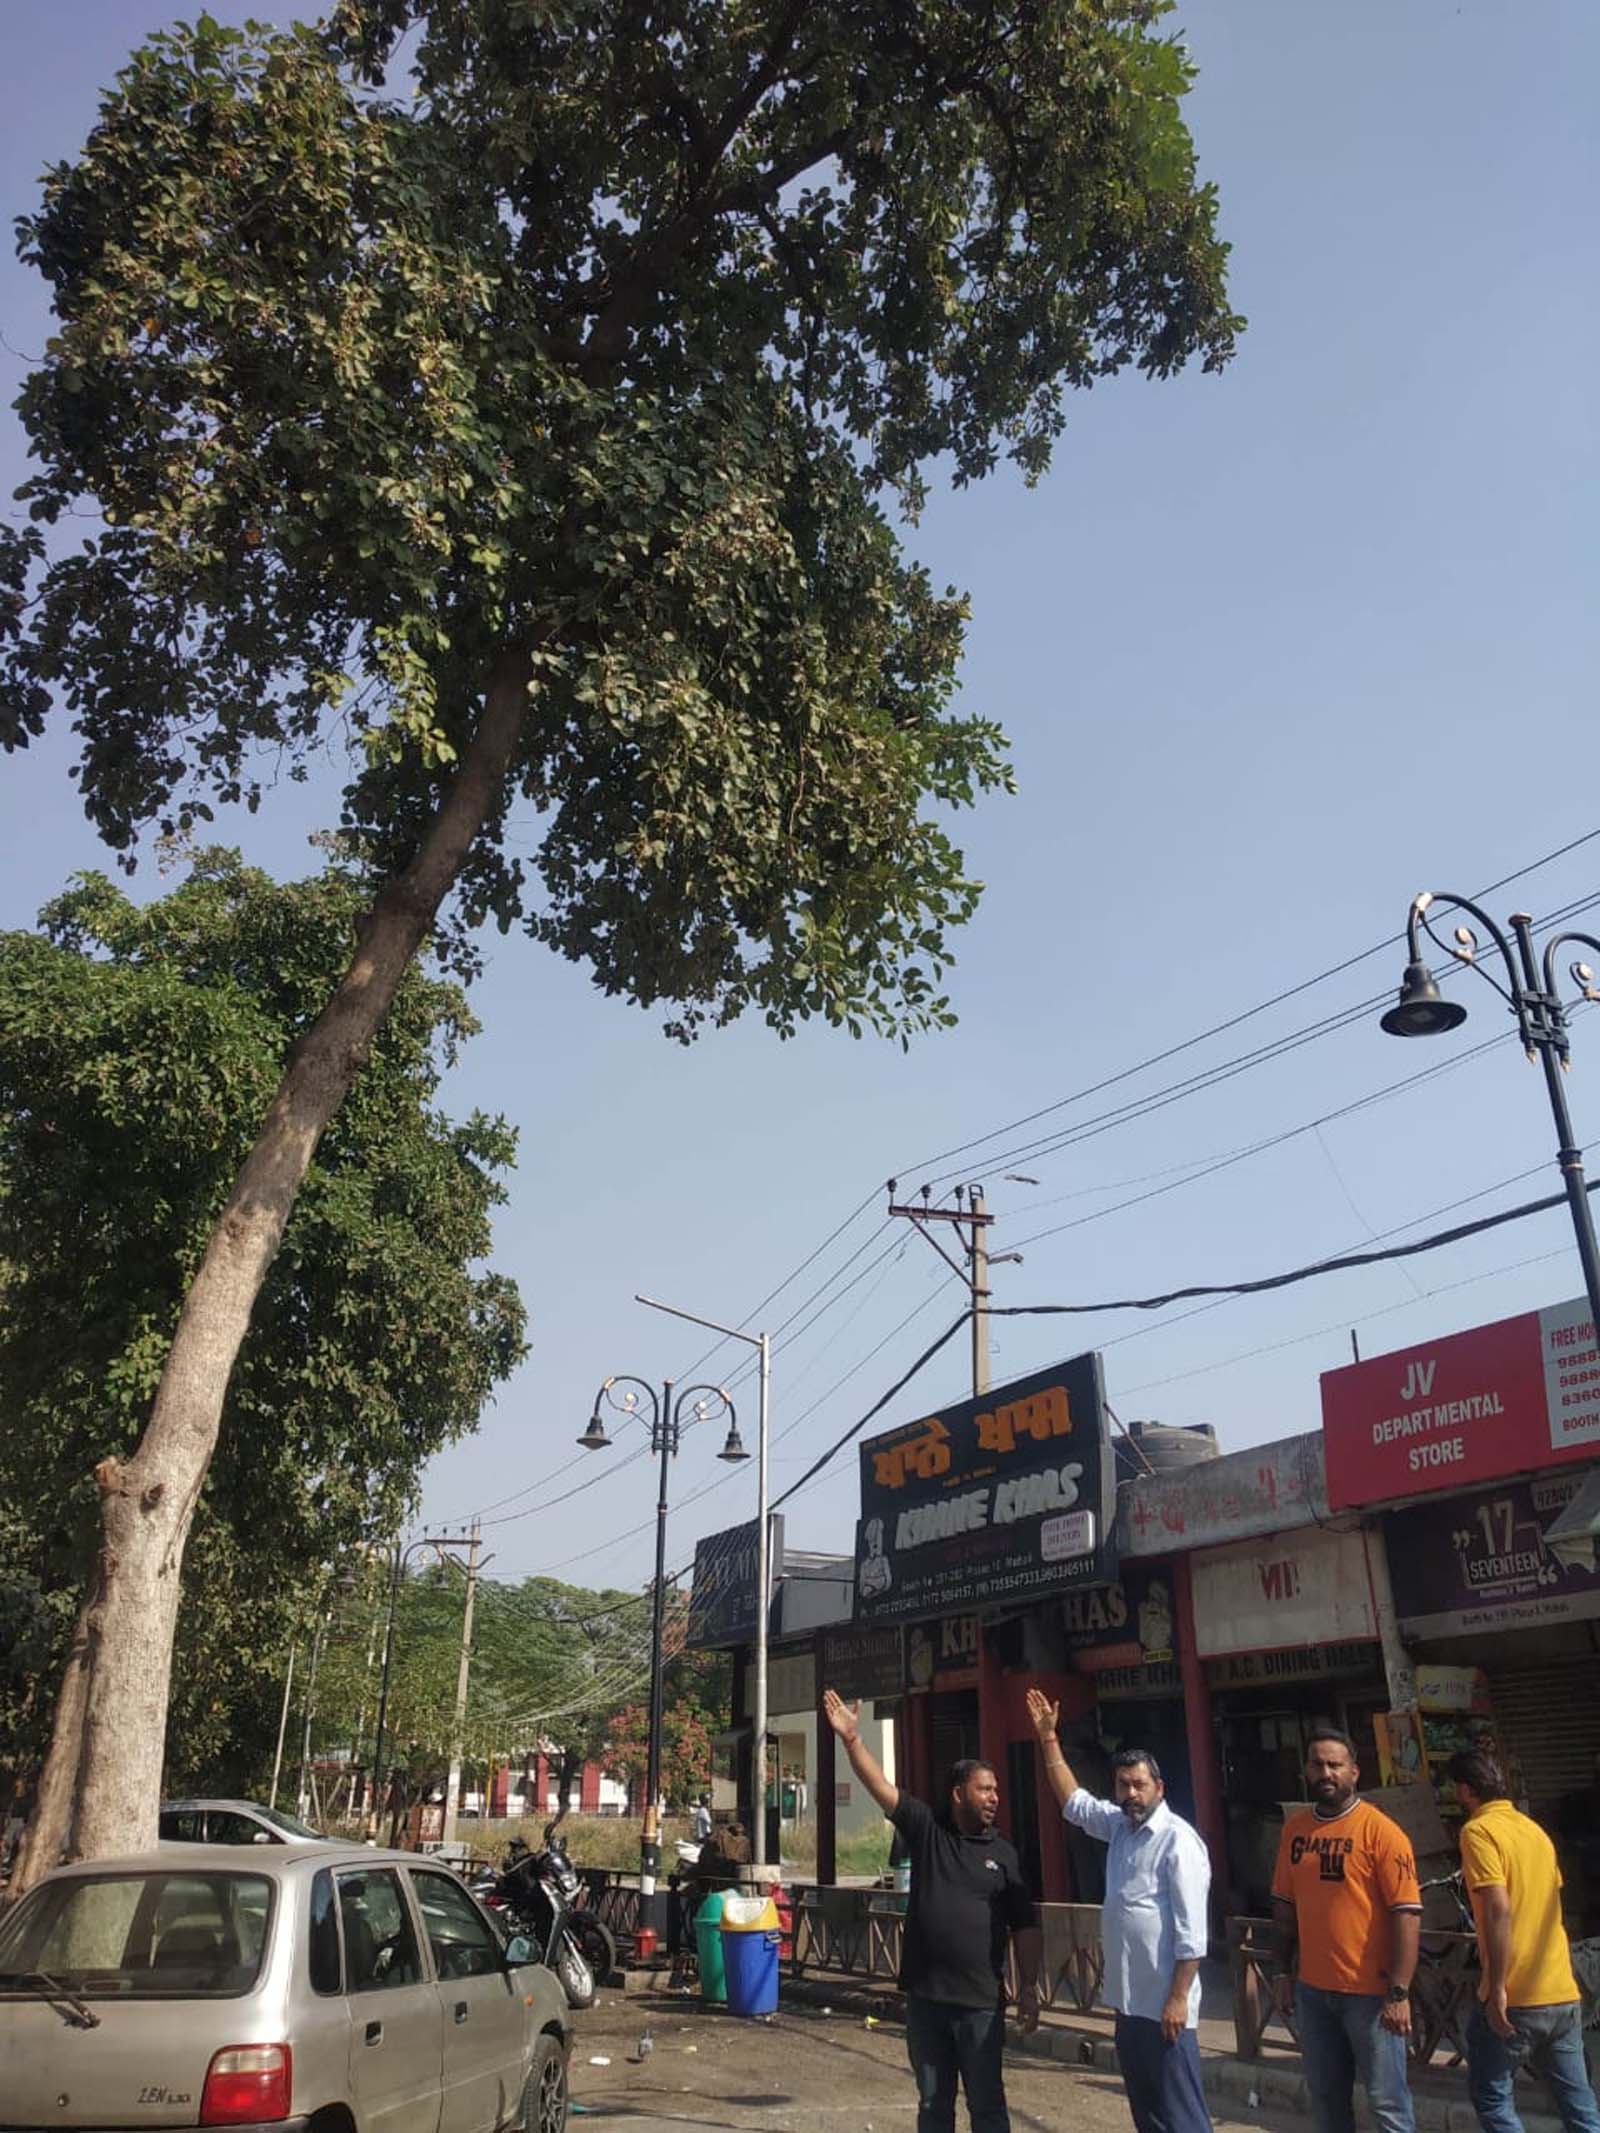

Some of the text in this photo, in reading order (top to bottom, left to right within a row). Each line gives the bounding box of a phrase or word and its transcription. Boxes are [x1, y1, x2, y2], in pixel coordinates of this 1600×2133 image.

[1551, 1322, 1597, 1349] FREE HO
[1558, 1349, 1600, 1369] 9888
[1400, 1359, 1437, 1400] JV
[1560, 1368, 1600, 1388] 9888
[1408, 1437, 1465, 1471] STORE
[1477, 1499, 1513, 1555] 17
[1469, 1551, 1541, 1580] SEVENTEEN
[1290, 1835, 1354, 1864] GIANTS
[137, 2087, 168, 2104] ZEN
